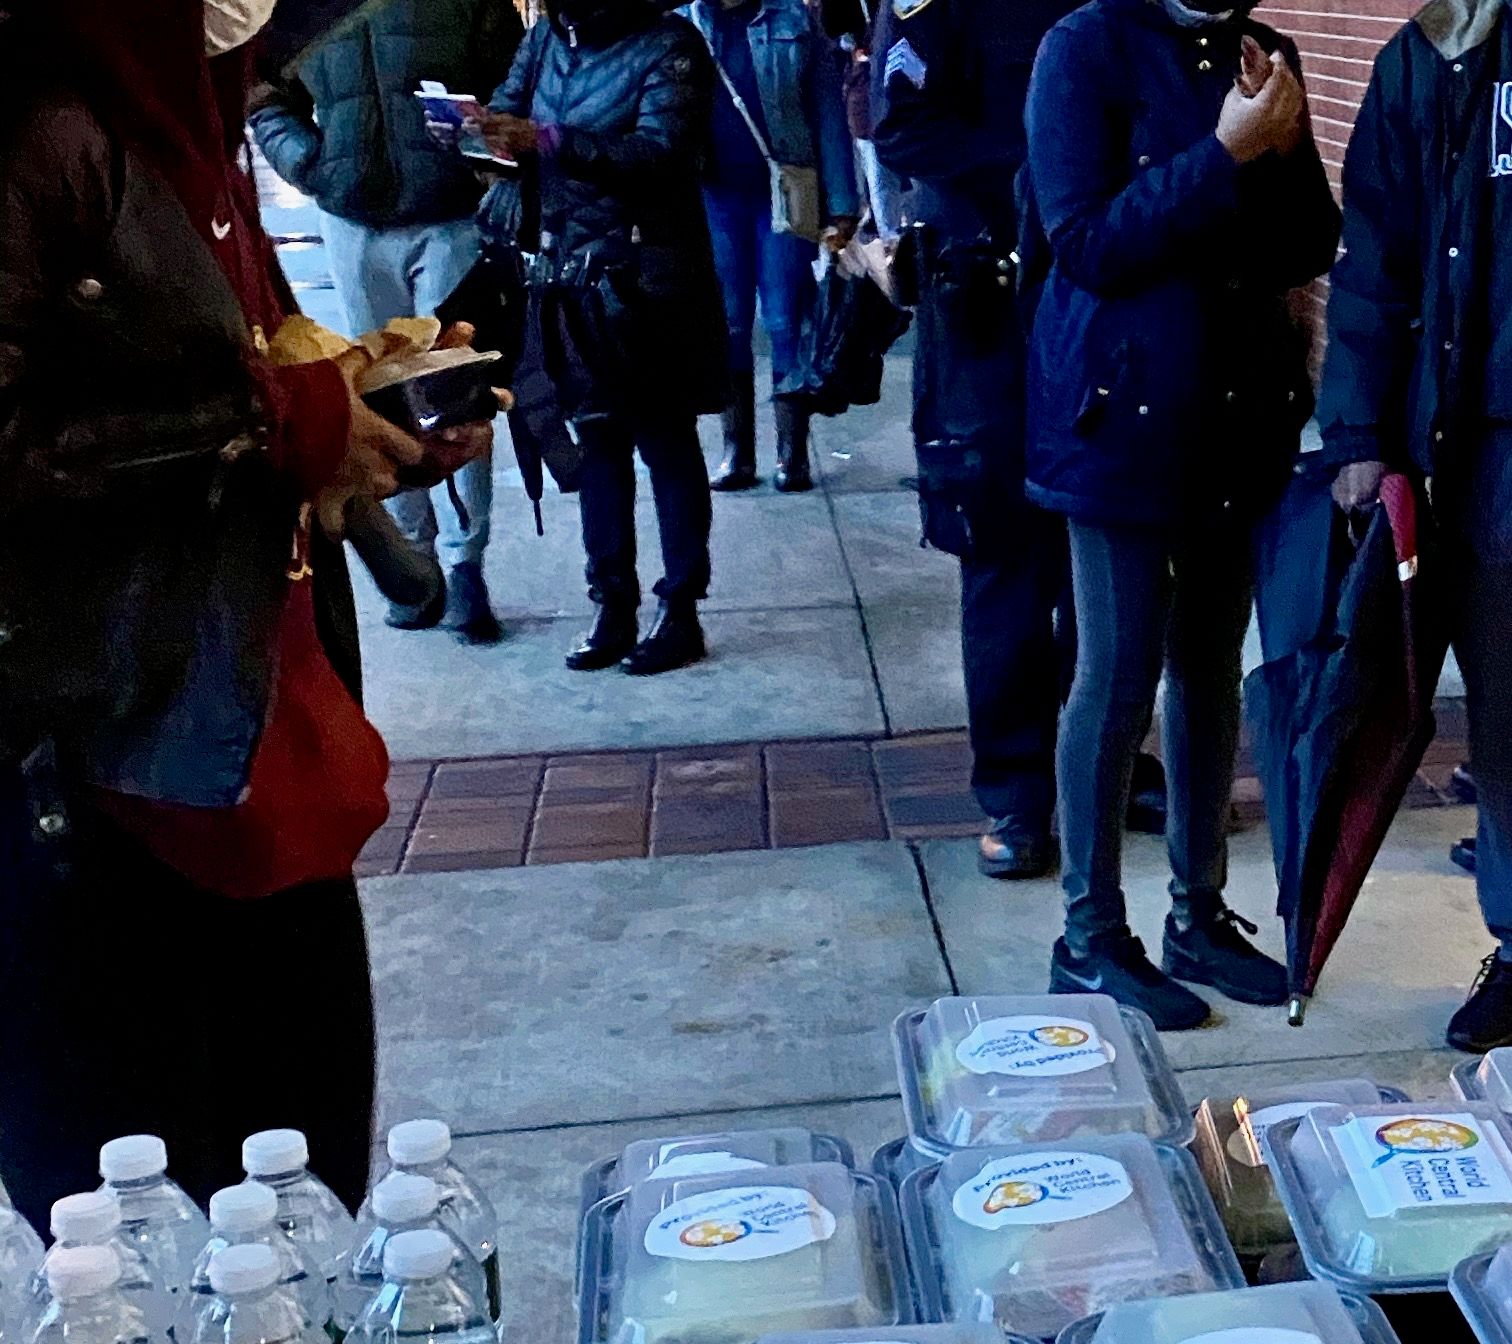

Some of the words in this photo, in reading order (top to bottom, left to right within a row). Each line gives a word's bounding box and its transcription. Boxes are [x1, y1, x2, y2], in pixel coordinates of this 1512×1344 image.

[1400, 1159, 1433, 1202] Kitchen
[1428, 1158, 1467, 1199] Central
[1454, 1157, 1491, 1189] World
